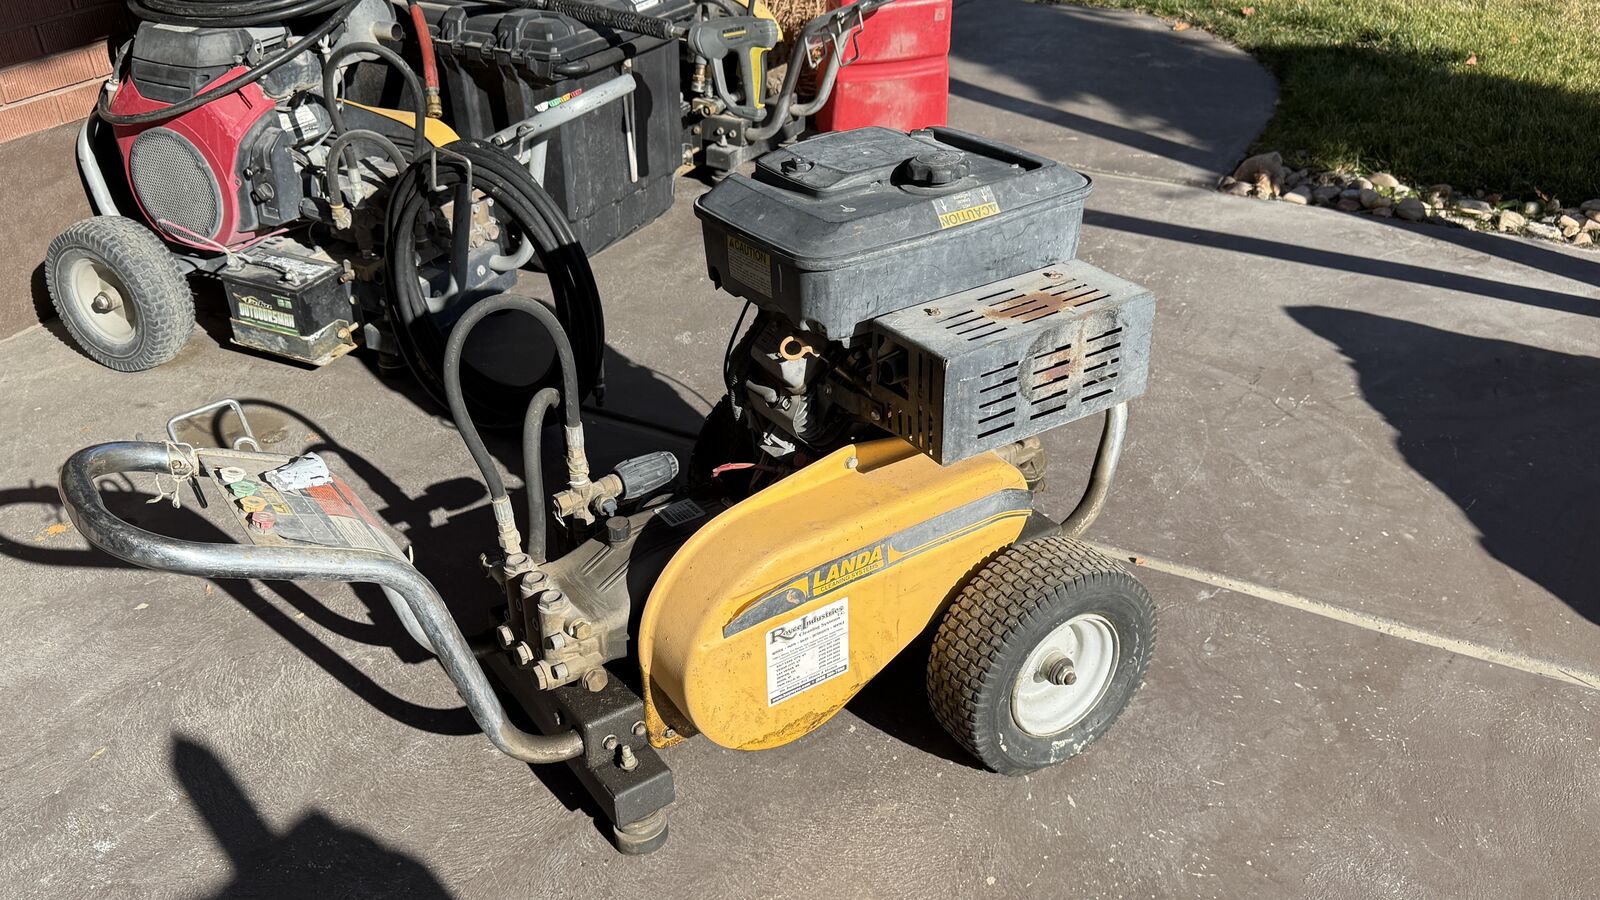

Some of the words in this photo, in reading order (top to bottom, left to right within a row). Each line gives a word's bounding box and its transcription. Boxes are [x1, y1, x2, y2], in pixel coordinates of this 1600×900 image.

[941, 204, 990, 227] CAUTION
[735, 240, 766, 264] CAUTION
[813, 546, 882, 588] LANDA
[820, 575, 851, 592] CLEANING
[851, 563, 880, 580] SYSTEMS
